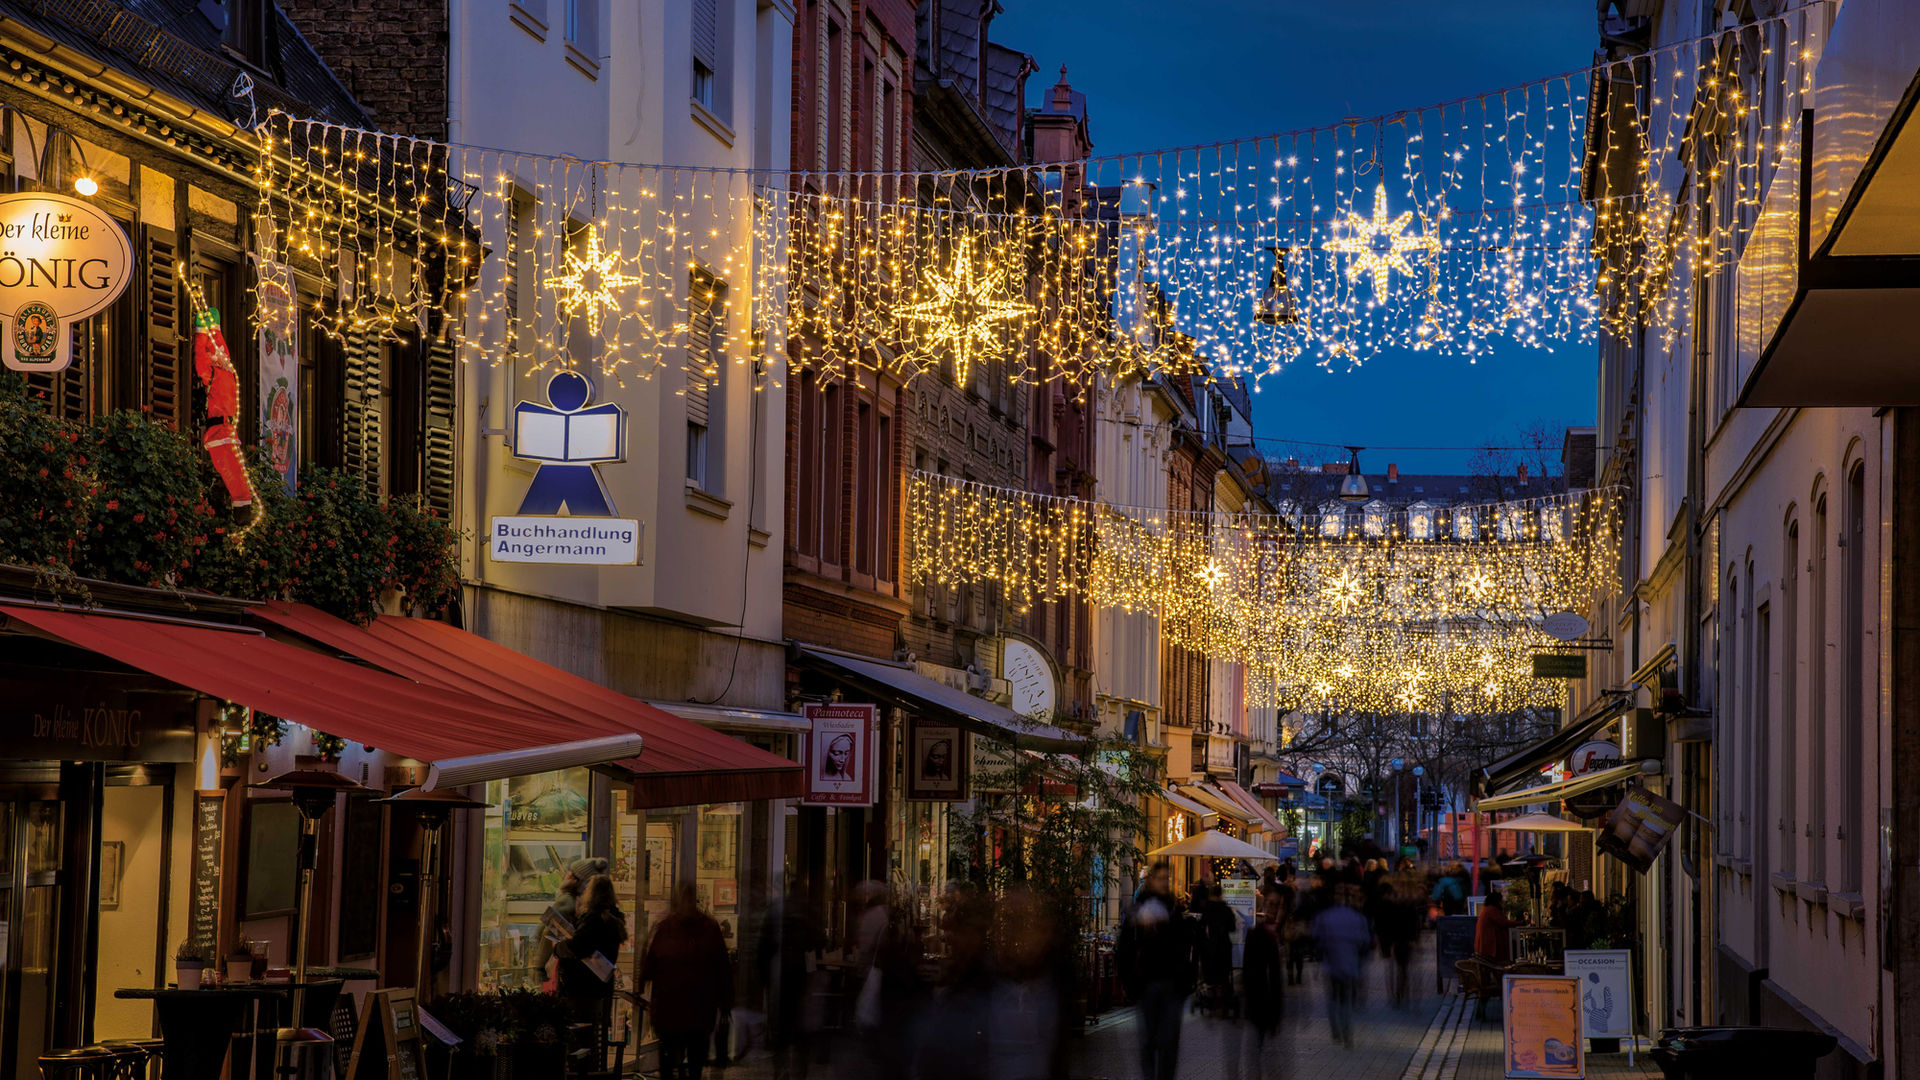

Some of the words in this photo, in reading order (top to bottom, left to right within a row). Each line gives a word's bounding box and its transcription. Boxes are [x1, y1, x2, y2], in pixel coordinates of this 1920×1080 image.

[0, 221, 25, 239] er
[31, 212, 90, 242] kleine
[0, 250, 110, 290] ÖNIG
[497, 523, 632, 544] Buchhandlung
[497, 540, 607, 557] Angermann
[33, 713, 51, 737] Der
[53, 704, 79, 742] kleine
[81, 700, 142, 749] KÖNIG
[812, 707, 865, 718] Paninoteca
